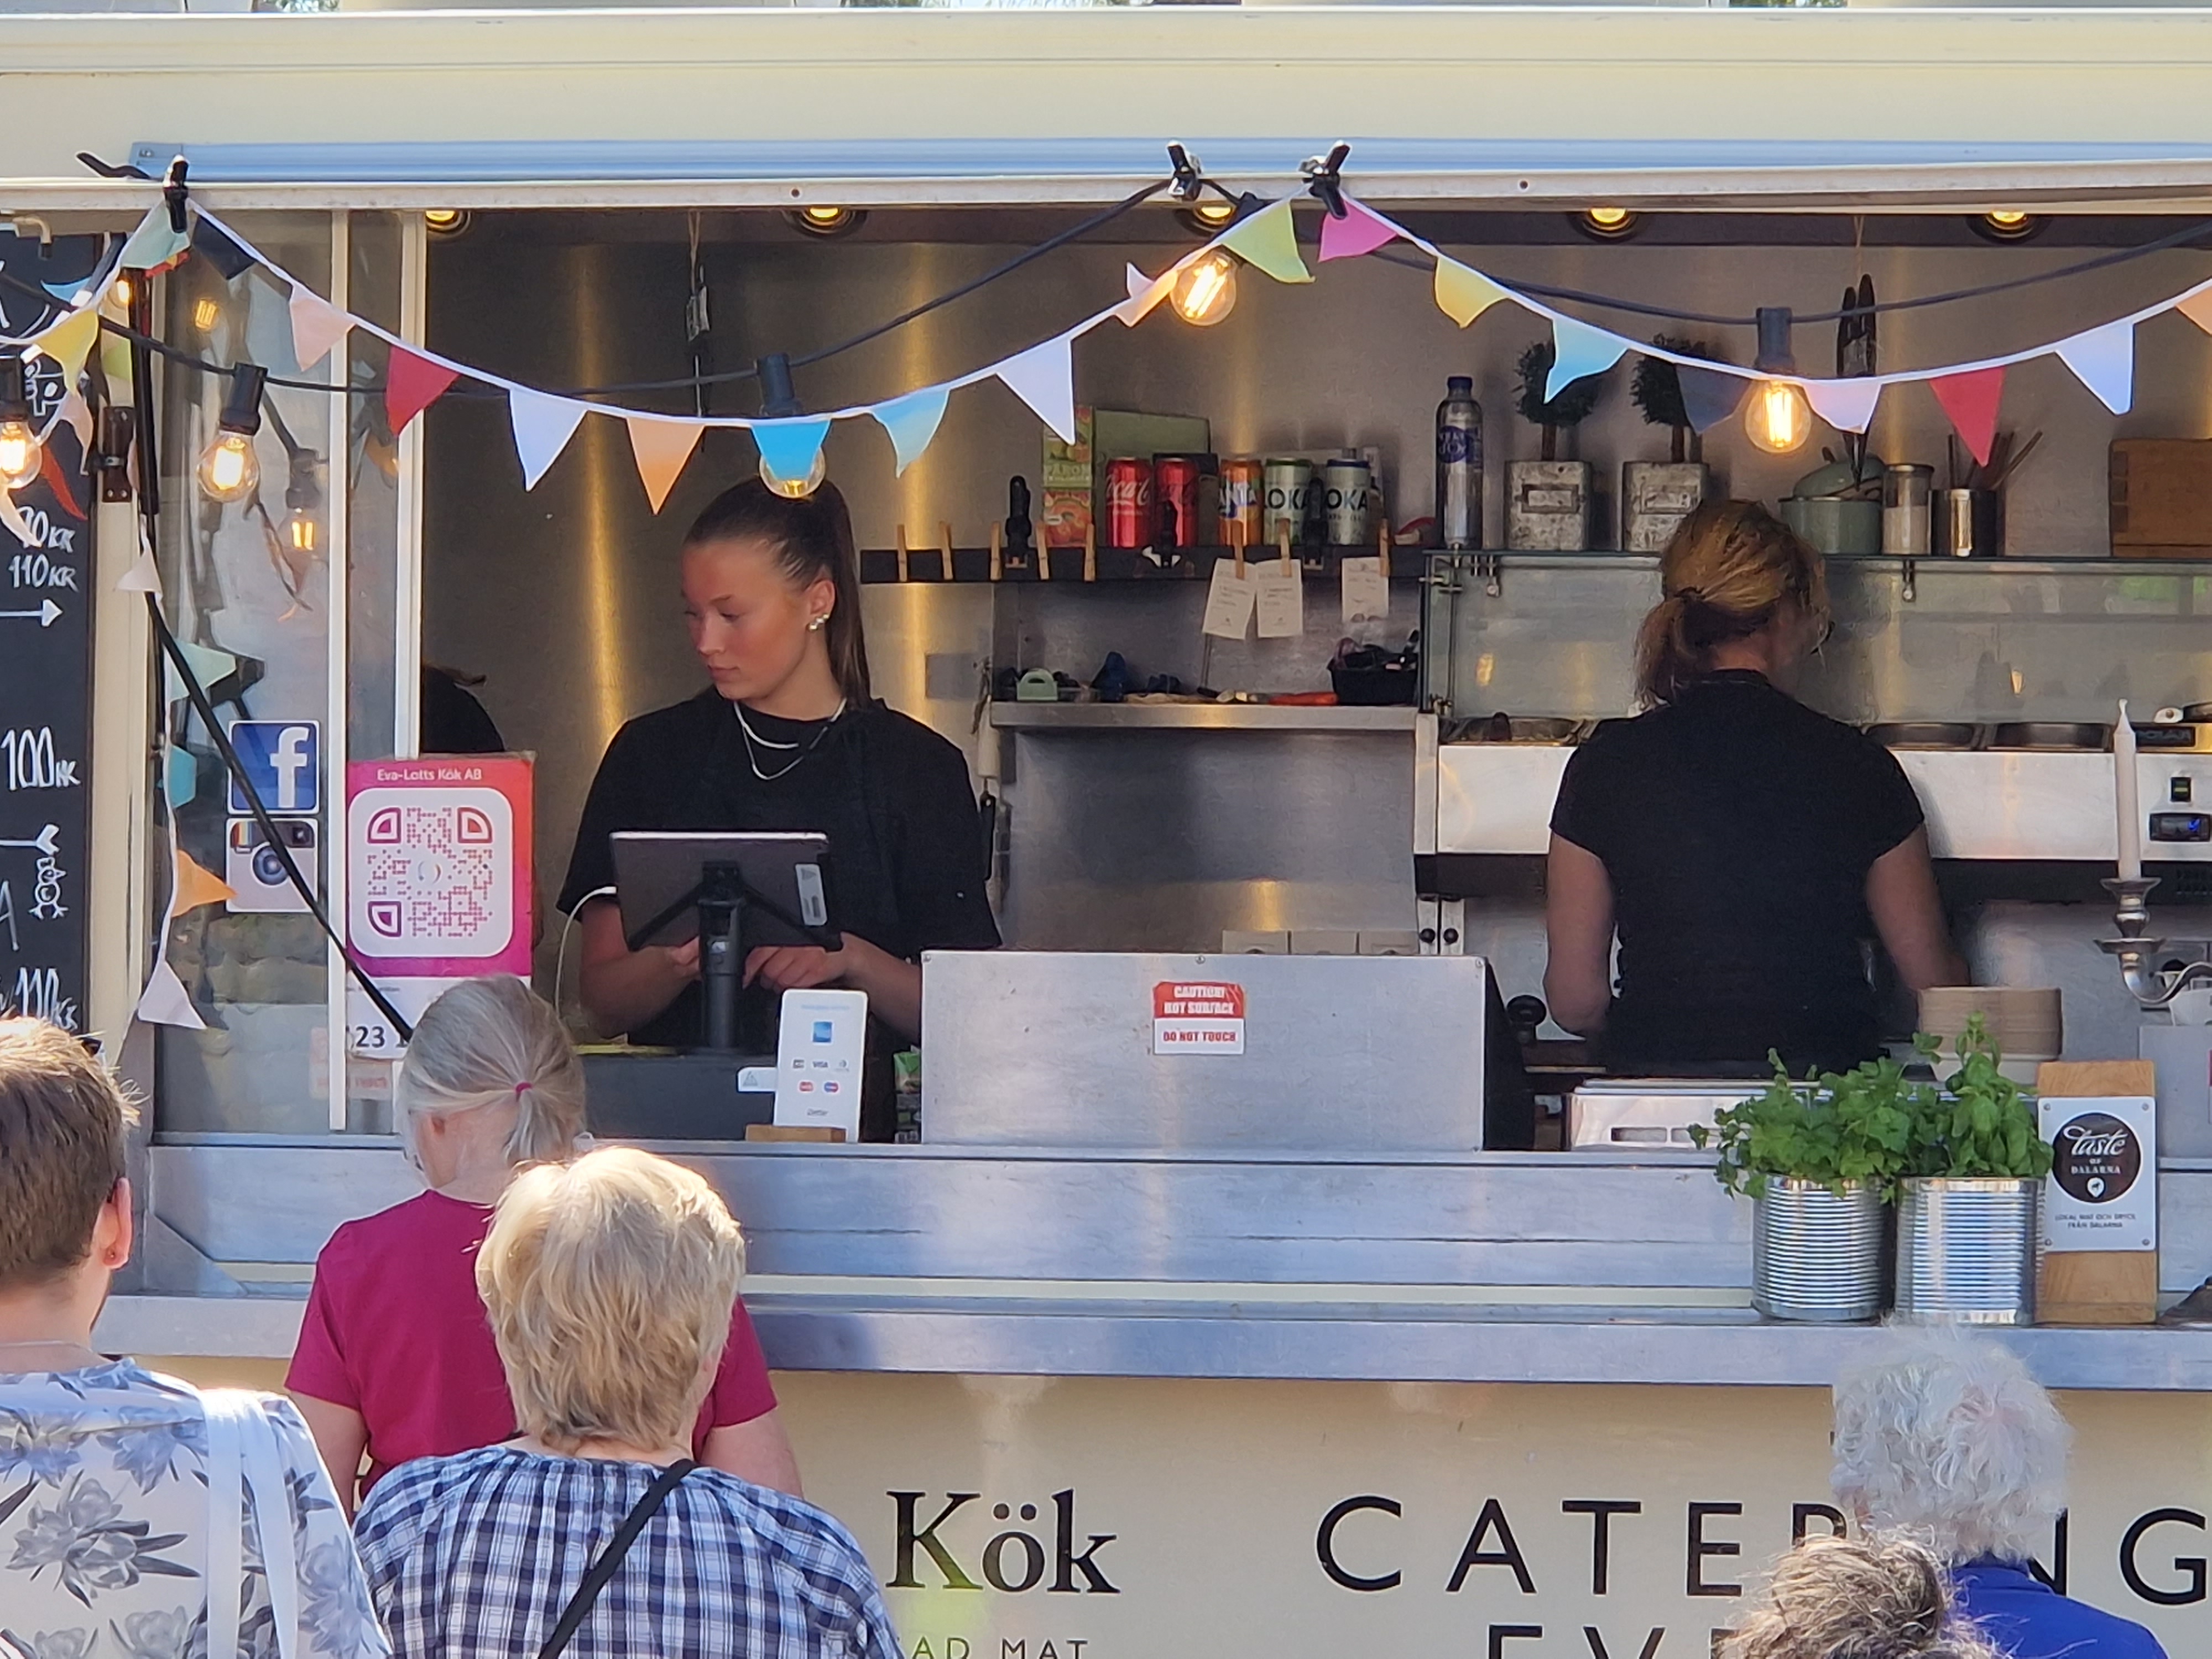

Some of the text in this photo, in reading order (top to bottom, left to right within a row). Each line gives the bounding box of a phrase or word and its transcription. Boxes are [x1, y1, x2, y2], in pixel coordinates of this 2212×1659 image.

[1327, 488, 1368, 510] OKA
[464, 768, 482, 780] AB
[1173, 986, 1226, 998] CAUTION
[1187, 1002, 1234, 1014] SURFACE
[1163, 1031, 1236, 1042] DO NOT TOUCH
[2063, 1125, 2128, 1155] Taste
[2071, 1165, 2121, 1175] DALARNA
[885, 1488, 1120, 1593] Kök
